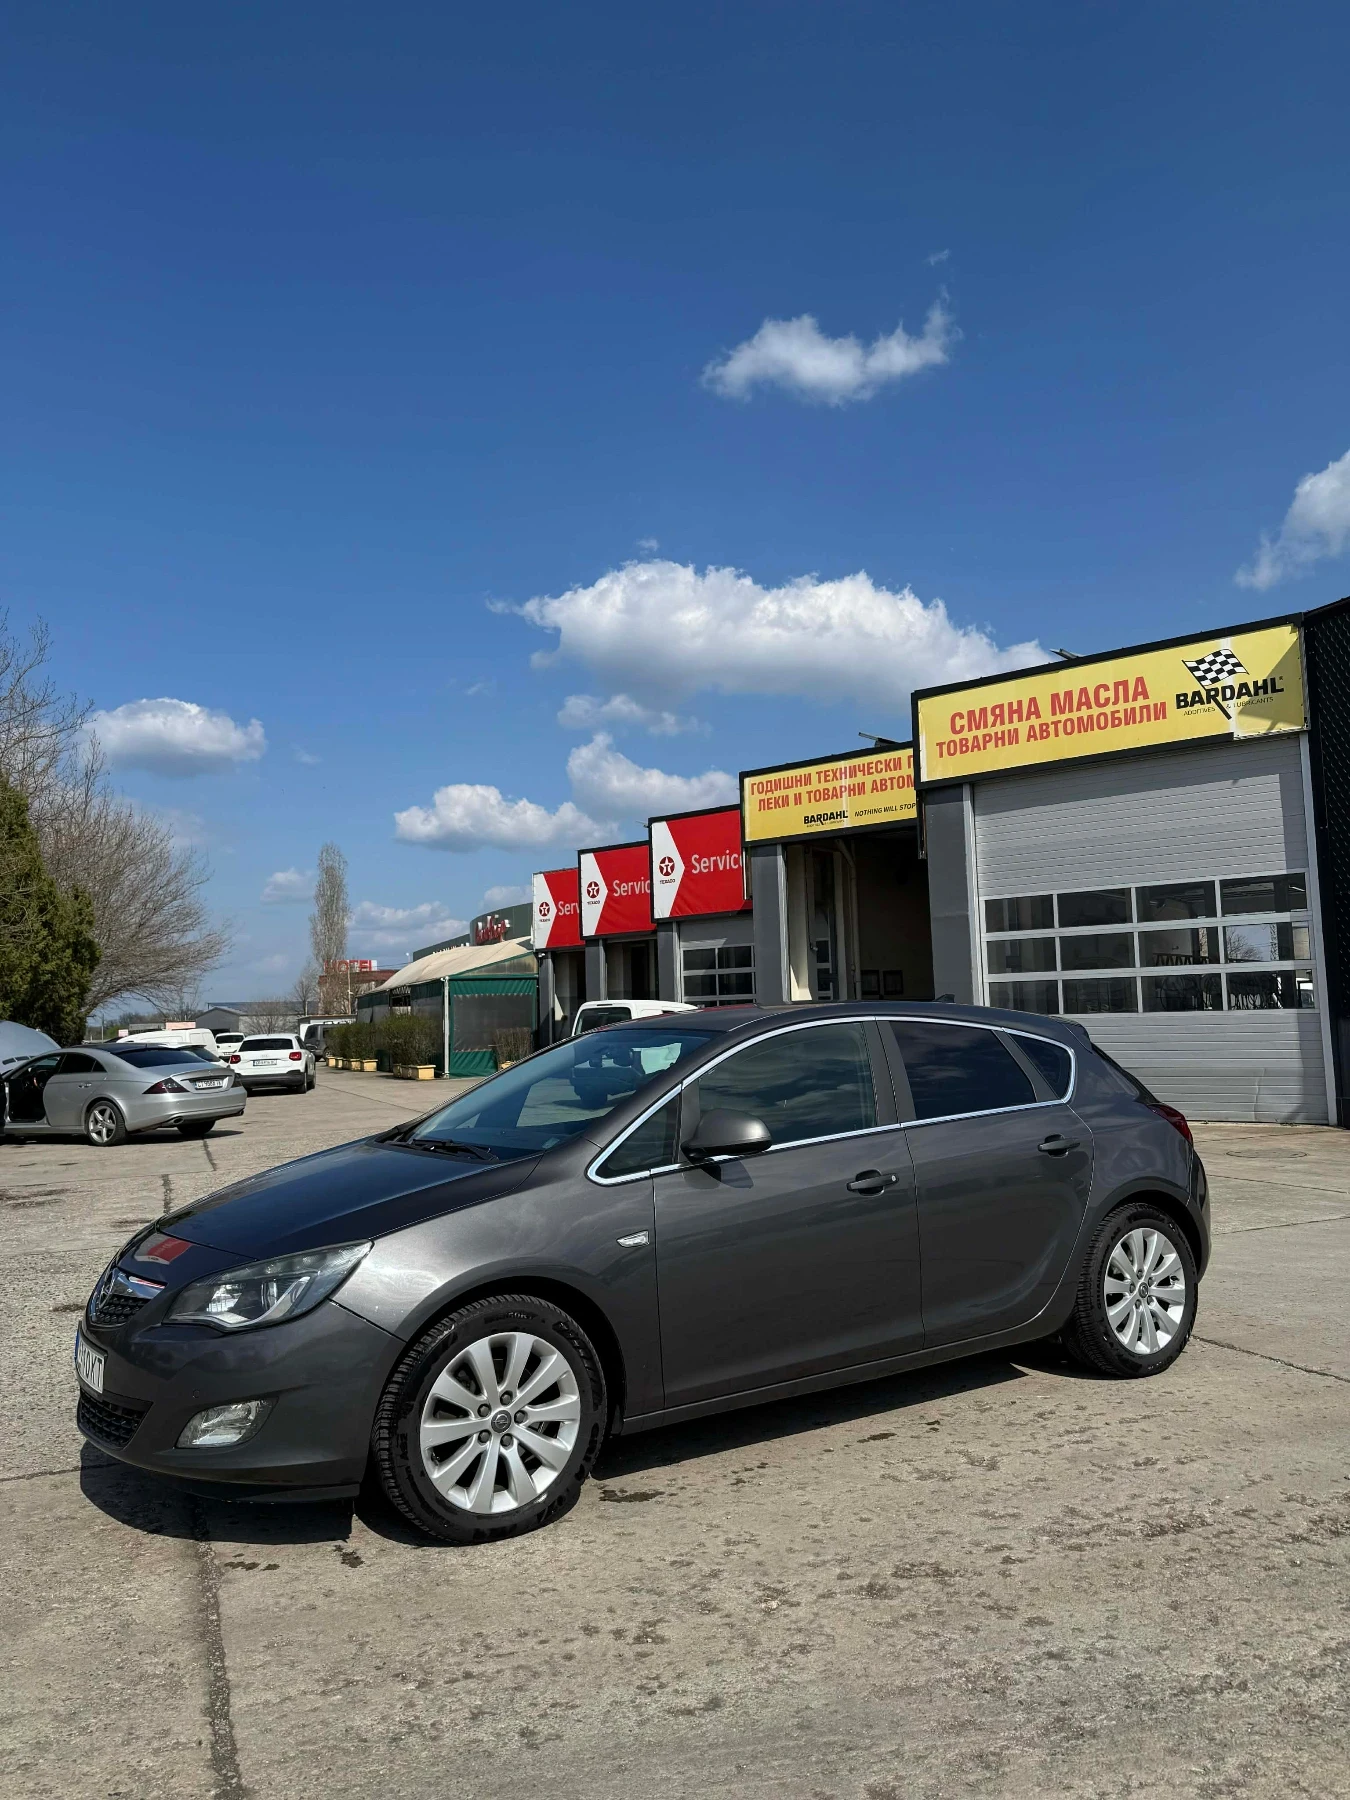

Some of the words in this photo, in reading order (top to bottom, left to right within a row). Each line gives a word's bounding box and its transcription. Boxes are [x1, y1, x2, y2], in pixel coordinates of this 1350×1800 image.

[949, 696, 1042, 736] СМЯНА
[1050, 676, 1150, 717] МАСЛА
[1175, 677, 1285, 712] BARDAHL
[1183, 707, 1216, 716] ADDITIVES
[1233, 696, 1274, 709] LUBRICANTS
[936, 727, 1020, 759] ТОВАРНИ
[1026, 701, 1168, 743] АВТОМОБИЛИ
[750, 772, 812, 796] ГОДИШНИ
[816, 757, 902, 785] ТЕХНИЧЕСКИ
[758, 794, 790, 812] ЛЕКИ
[793, 792, 803, 806] И
[806, 781, 866, 804] ТОВАРНИ
[854, 807, 883, 817] NOTHING
[883, 805, 898, 813] WILL
[899, 802, 916, 811] STOP
[804, 811, 848, 825] BARDAHL
[691, 849, 743, 874] Servic
